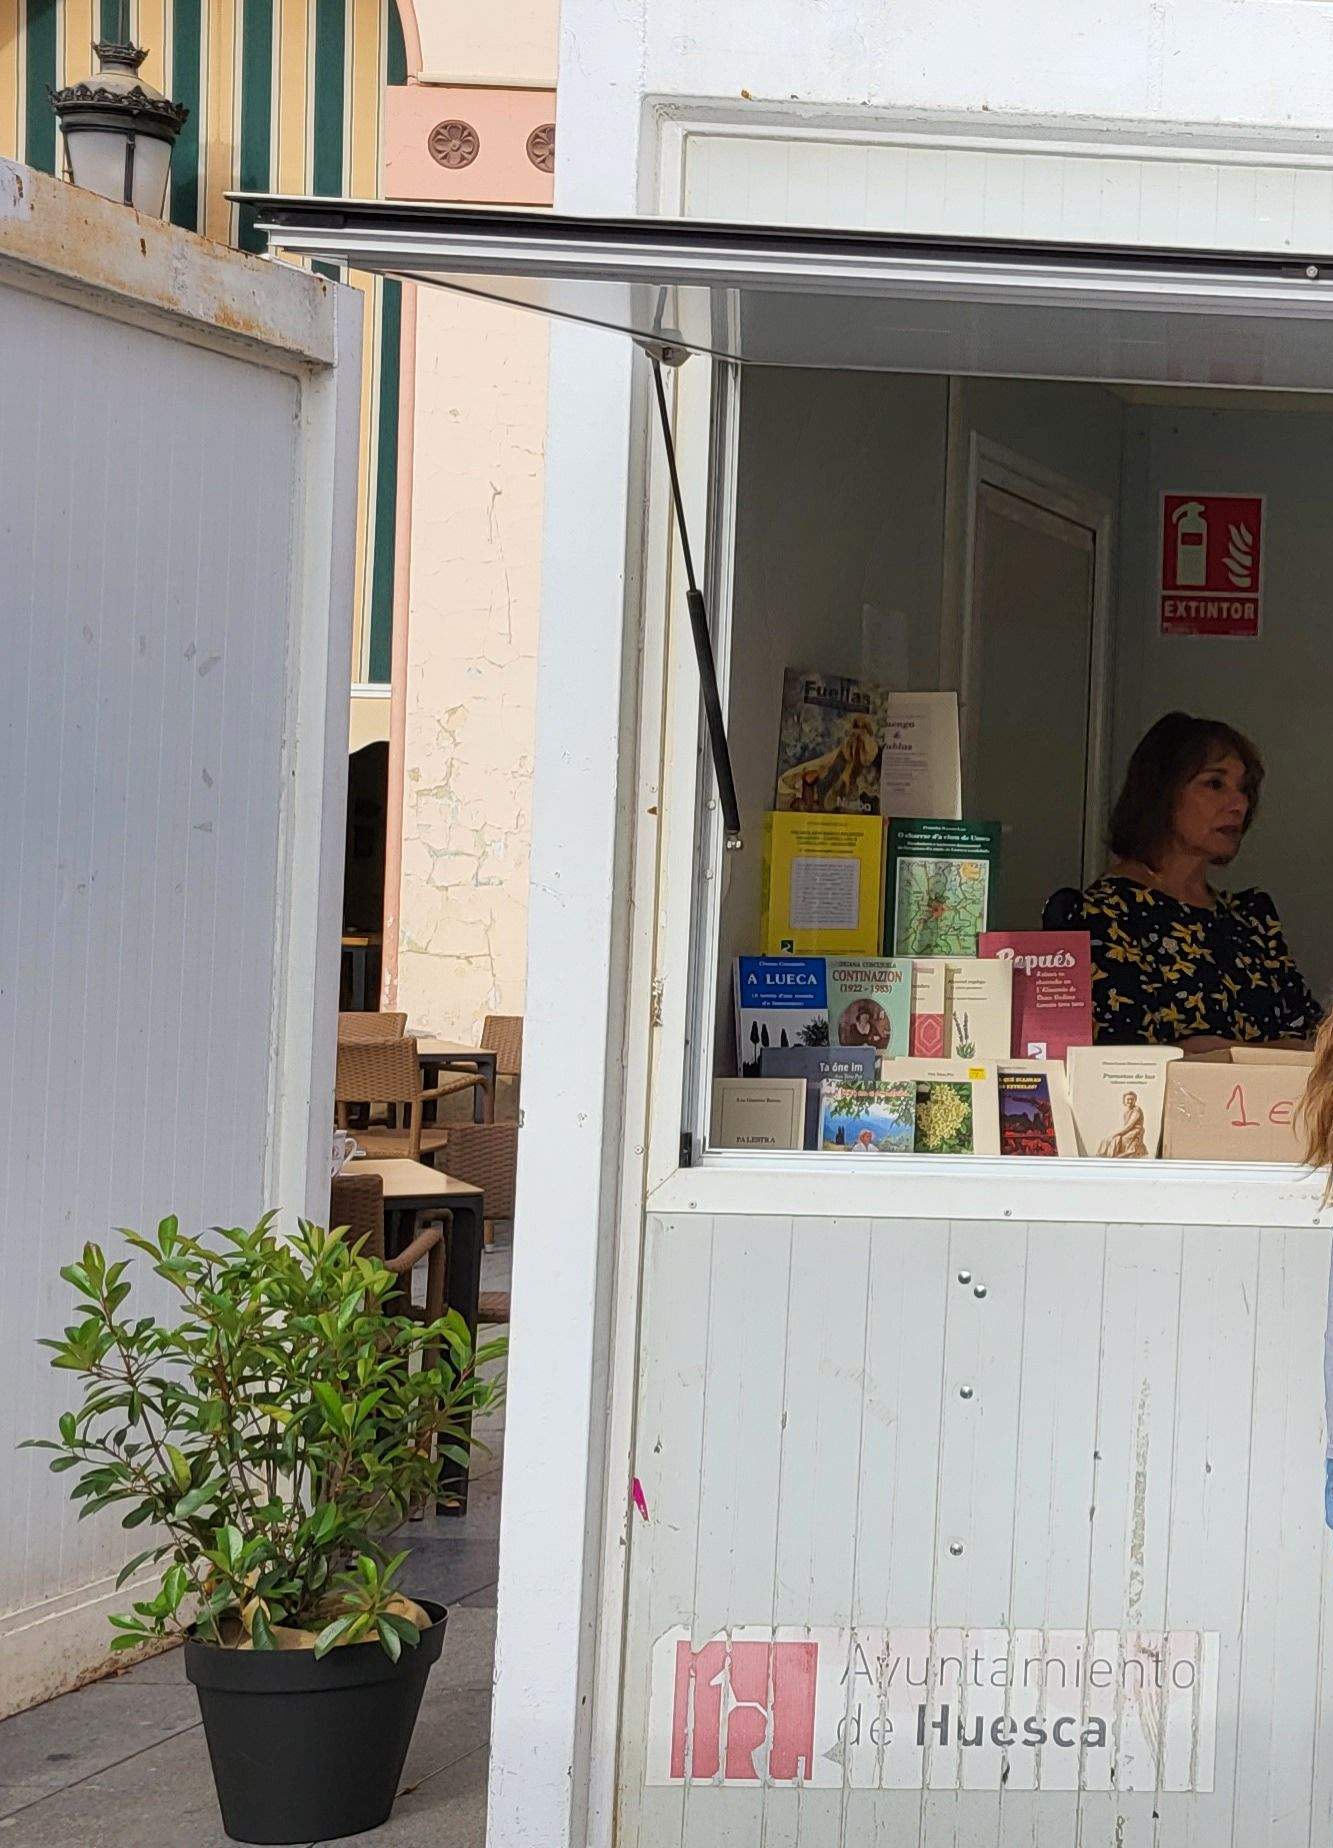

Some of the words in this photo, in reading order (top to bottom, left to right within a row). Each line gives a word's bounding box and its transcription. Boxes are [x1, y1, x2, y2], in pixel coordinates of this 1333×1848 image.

[1164, 601, 1255, 620] EXTINTOR
[804, 678, 871, 703] Fuellas
[747, 973, 758, 985] A
[765, 973, 818, 985] LUECA
[832, 969, 903, 983] CONTINAZION
[736, 1136, 776, 1144] PALESTRA
[839, 1642, 1198, 1693] Ayuntamiento
[836, 1704, 894, 1747] de
[916, 1703, 1107, 1748] Huesca
